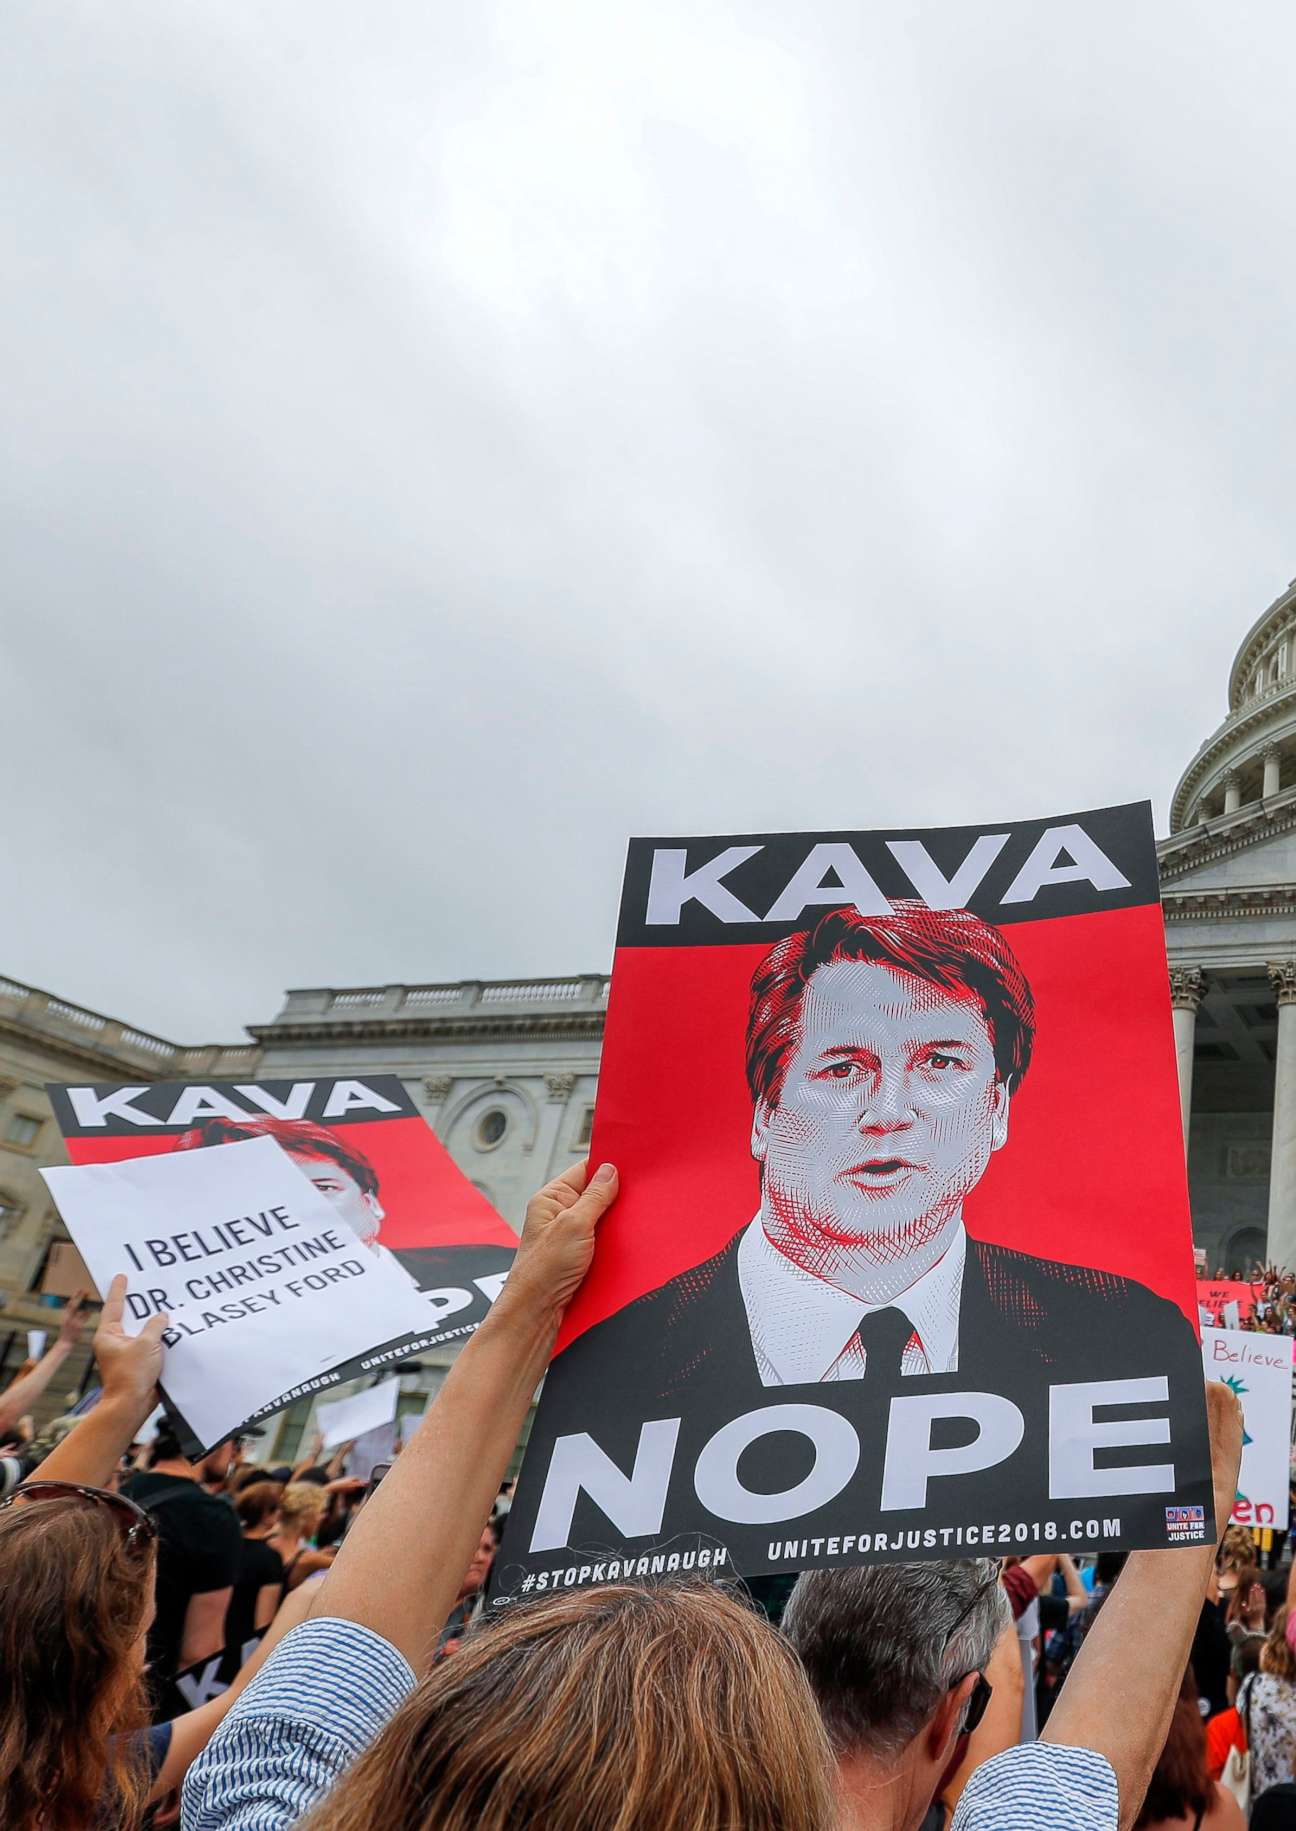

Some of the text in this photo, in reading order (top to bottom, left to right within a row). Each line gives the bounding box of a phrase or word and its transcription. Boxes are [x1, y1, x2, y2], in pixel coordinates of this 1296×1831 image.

[645, 824, 1132, 925] KAVA
[66, 1080, 402, 1128] KAVA
[124, 1205, 300, 1272] I BELIEVE
[126, 1230, 346, 1320] DR. CHRISTINE
[161, 1259, 366, 1349] BLASEY FORD
[1214, 1340, 1288, 1369] Believe
[530, 1376, 1175, 1552] NOPE
[767, 1518, 1121, 1562] UNITEFORJUSTICE2018.COM
[1167, 1521, 1205, 1531] UNITE FOR
[1168, 1531, 1204, 1541] JUSTICE
[521, 1548, 727, 1592] #STOPKAVANAUGH
